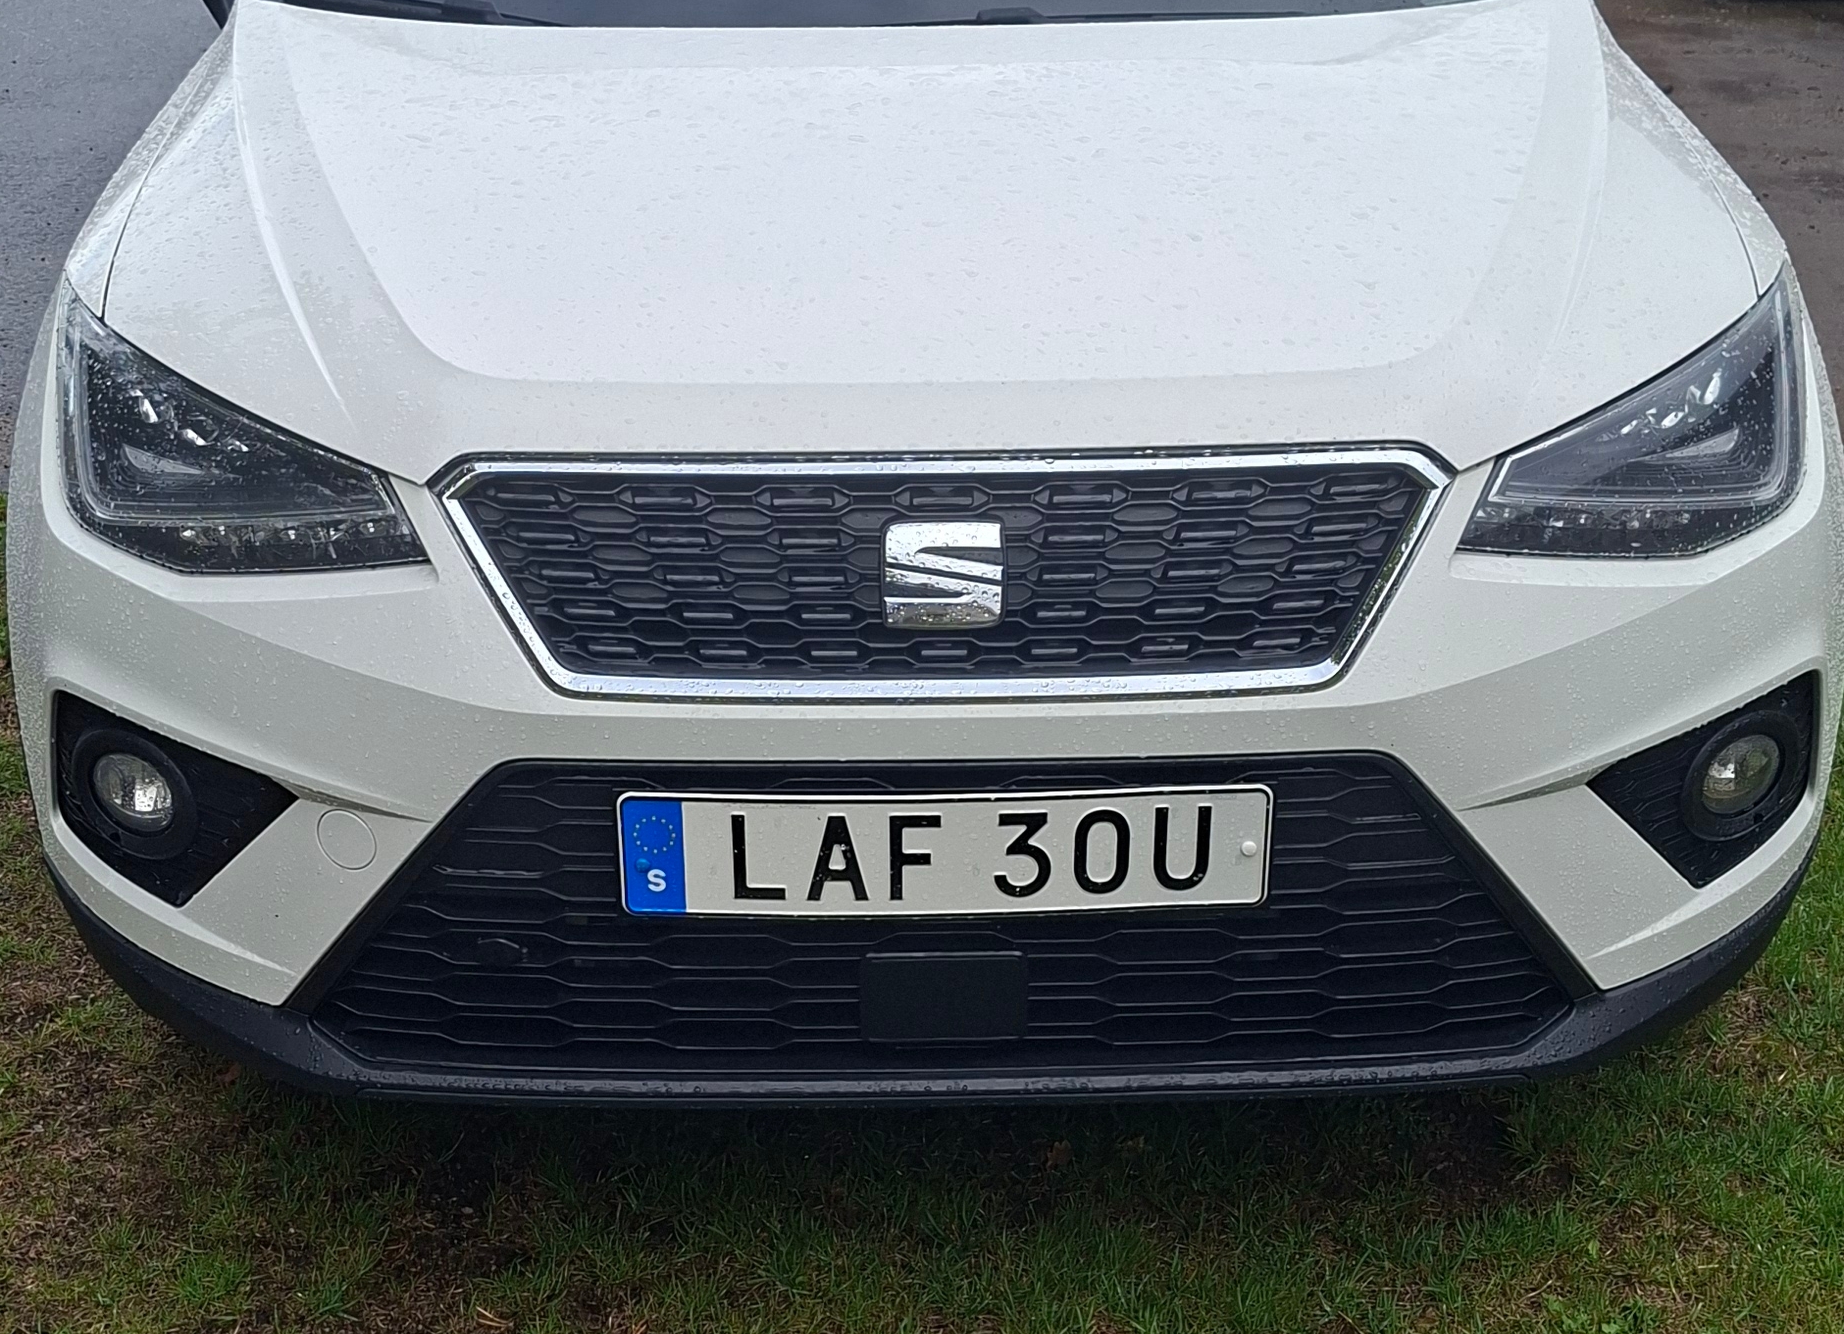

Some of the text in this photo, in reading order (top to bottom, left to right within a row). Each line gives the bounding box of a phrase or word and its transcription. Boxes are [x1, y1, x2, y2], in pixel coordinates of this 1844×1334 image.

[647, 869, 667, 892] S
[731, 805, 1213, 902] LAF 30U
